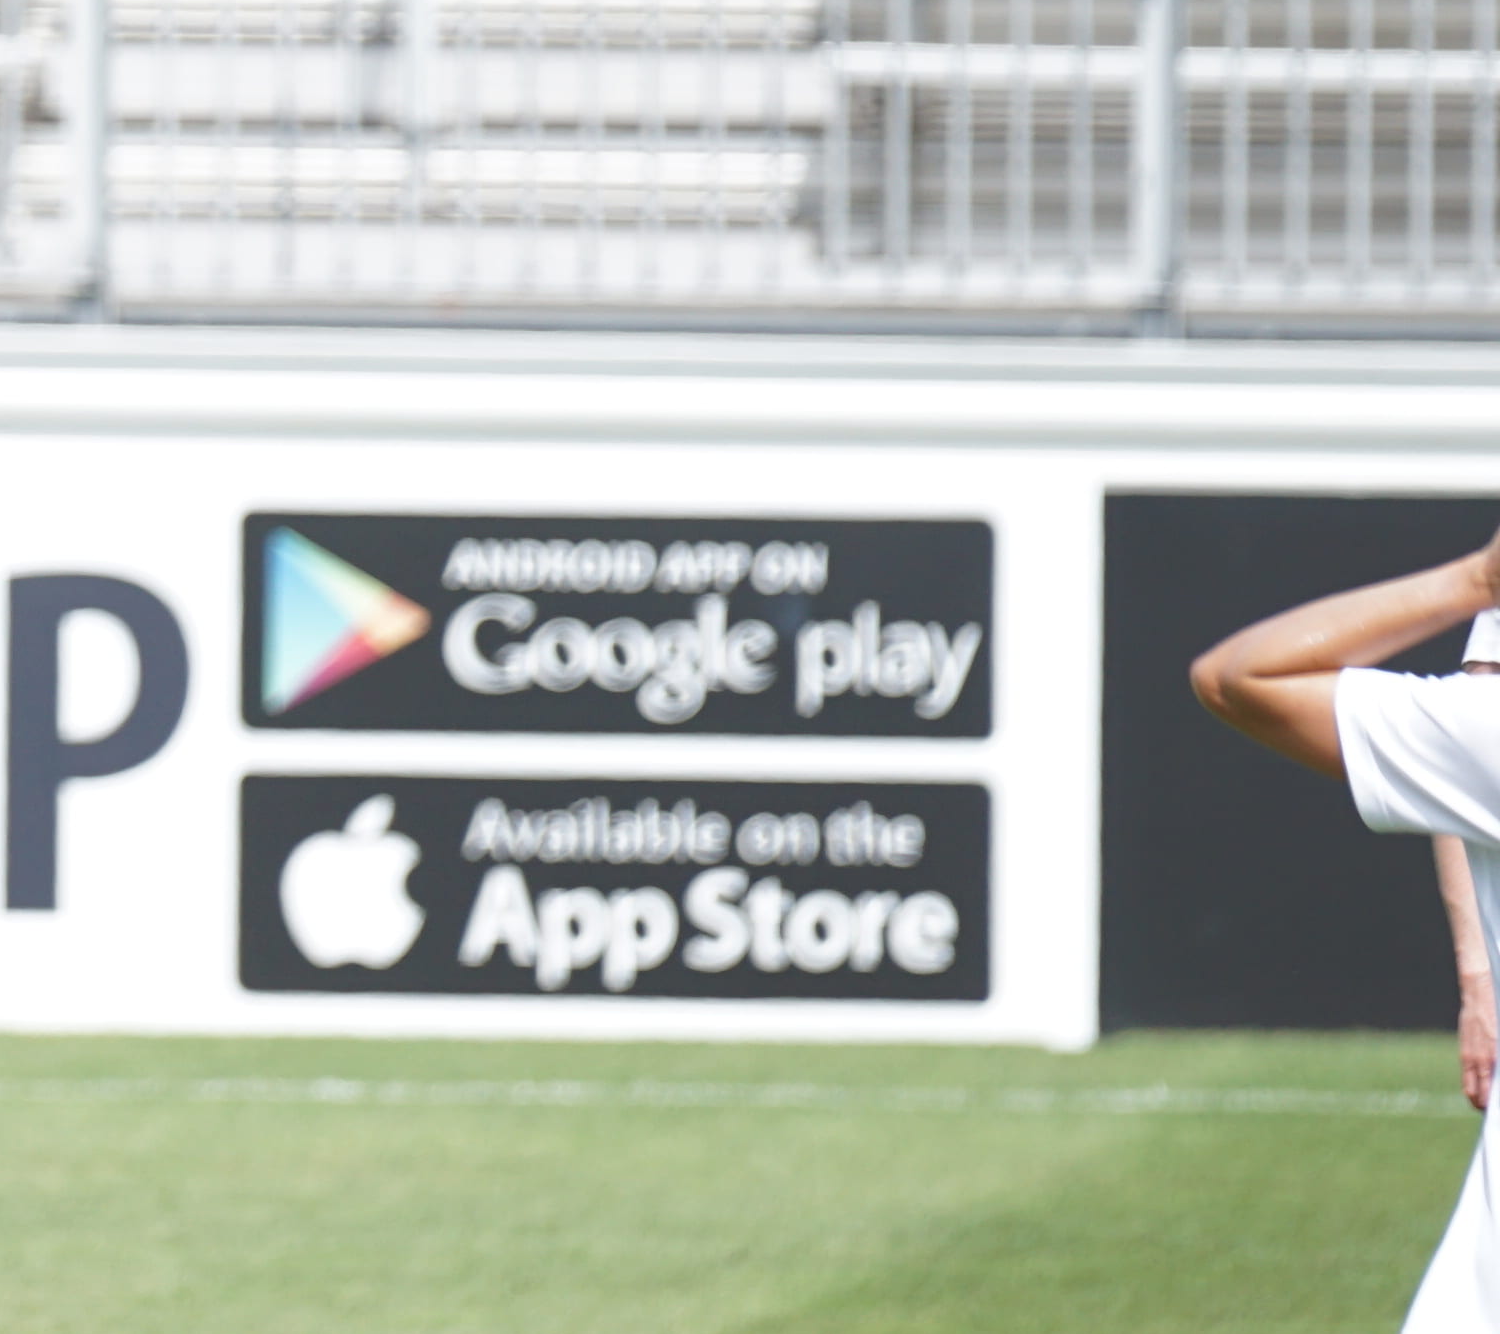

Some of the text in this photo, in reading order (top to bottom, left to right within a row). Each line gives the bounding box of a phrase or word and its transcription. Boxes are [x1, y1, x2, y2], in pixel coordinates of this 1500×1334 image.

[443, 537, 829, 595] ANDROID APP ON
[442, 592, 983, 725] Google play
[461, 796, 926, 867] Available on the
[458, 865, 960, 992] App Store
